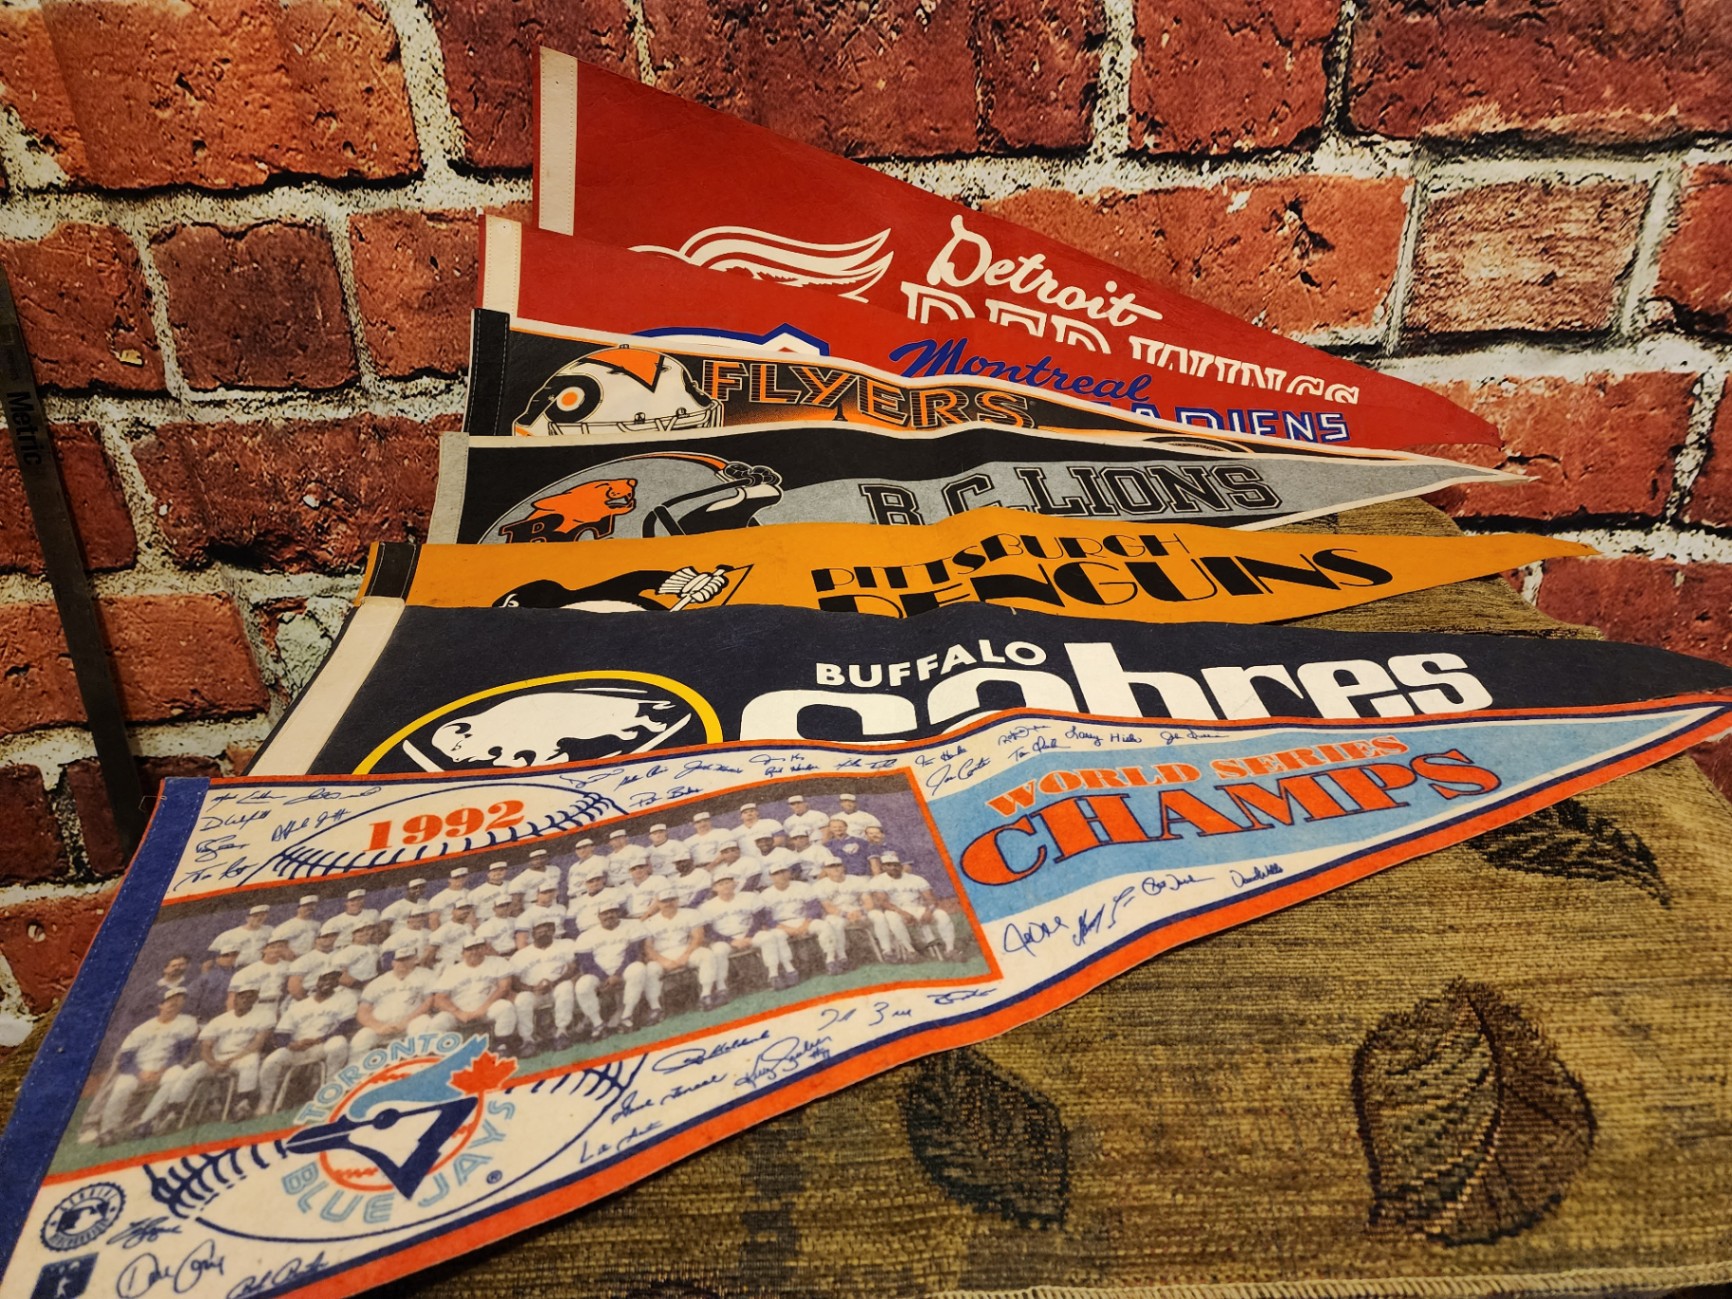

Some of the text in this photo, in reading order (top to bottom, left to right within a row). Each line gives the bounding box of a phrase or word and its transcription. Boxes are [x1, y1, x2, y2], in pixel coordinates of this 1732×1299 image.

[926, 214, 1163, 327] Detroit
[702, 359, 1036, 430] FLYERS
[888, 337, 1152, 402] Montreal
[6, 391, 43, 465] Metric
[1014, 464, 1284, 518] LIONS
[810, 532, 1191, 593] PITTSBURGH
[815, 638, 1047, 688] BUFFALO
[985, 735, 1410, 818] WORLD SERIES
[363, 799, 526, 853] 1992
[959, 748, 1502, 886] CHAMPS
[296, 1032, 462, 1122] TORONTO
[281, 1160, 396, 1224] BLUE
[418, 1100, 517, 1208] JAYS
